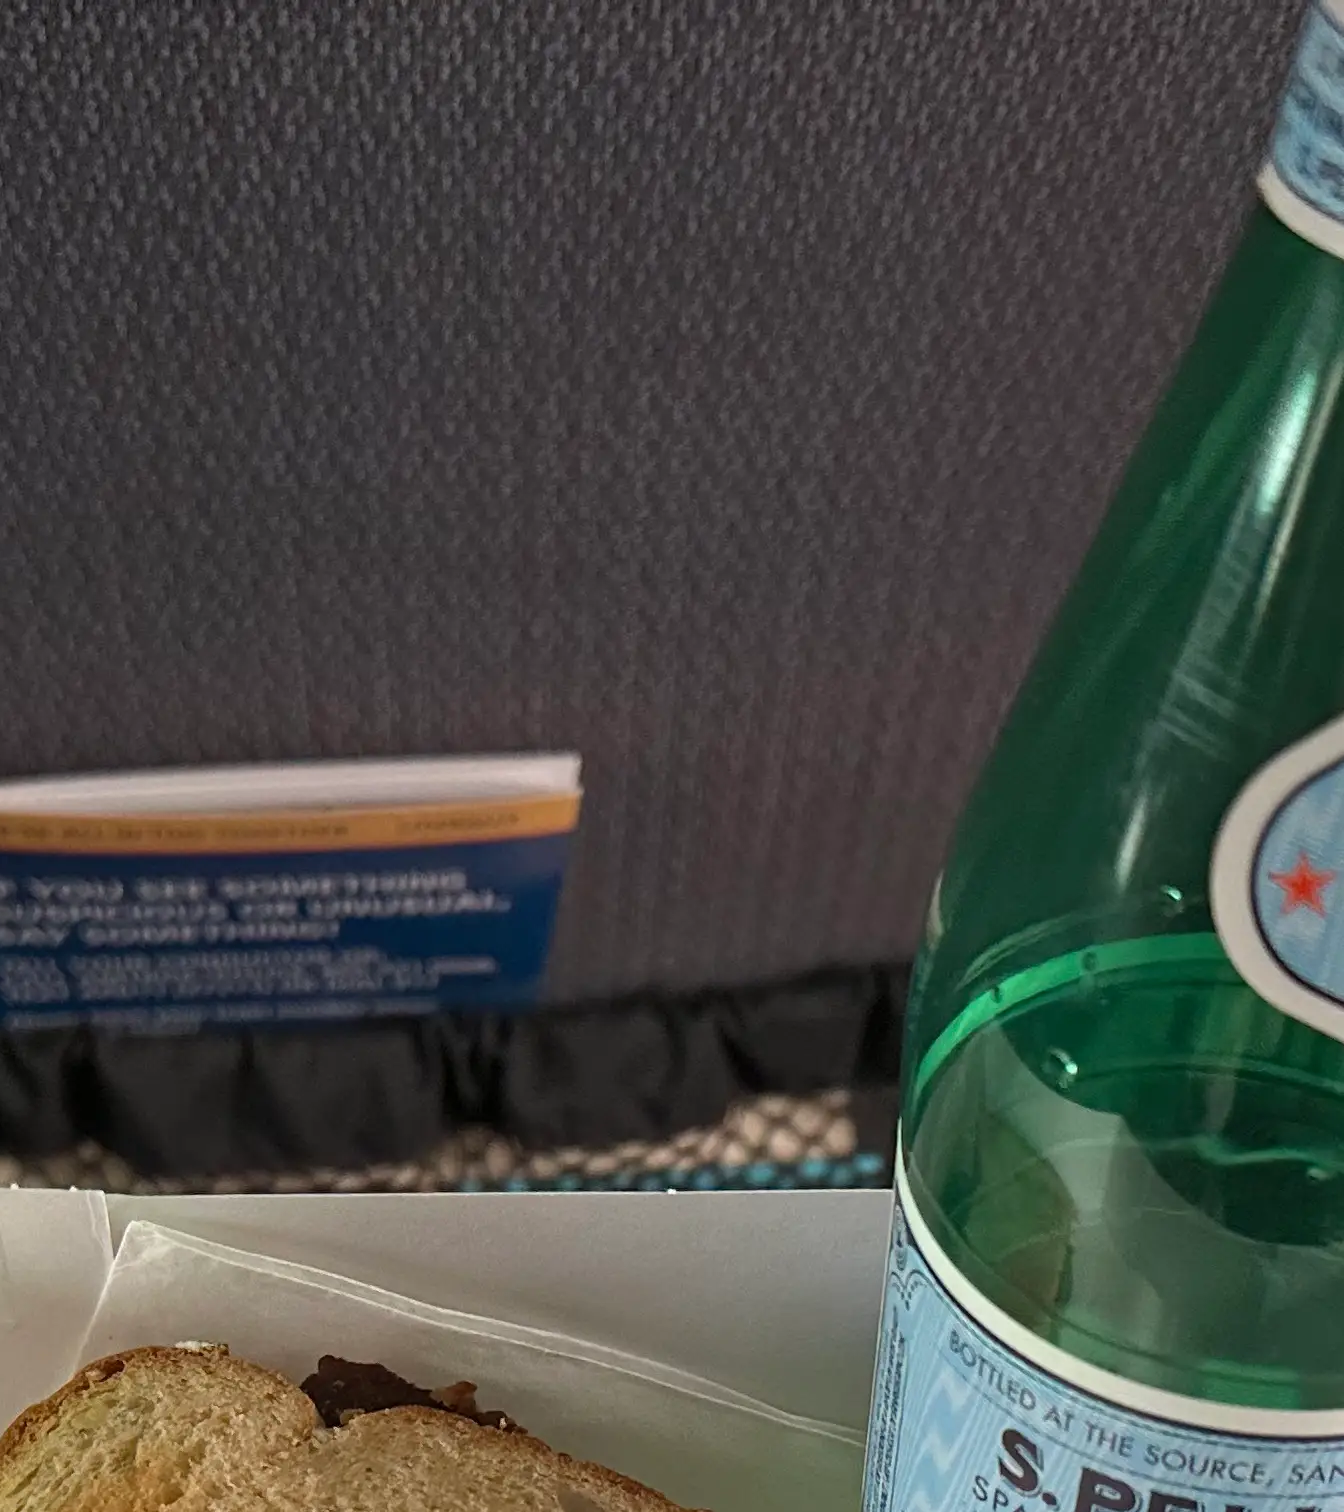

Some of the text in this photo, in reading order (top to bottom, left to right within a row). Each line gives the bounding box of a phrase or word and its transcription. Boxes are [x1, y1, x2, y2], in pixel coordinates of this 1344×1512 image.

[948, 1330, 1037, 1412] BOTTLED
[1042, 1405, 1076, 1432] AT
[1084, 1422, 1136, 1458] THE
[1142, 1443, 1275, 1488] SOURCE,
